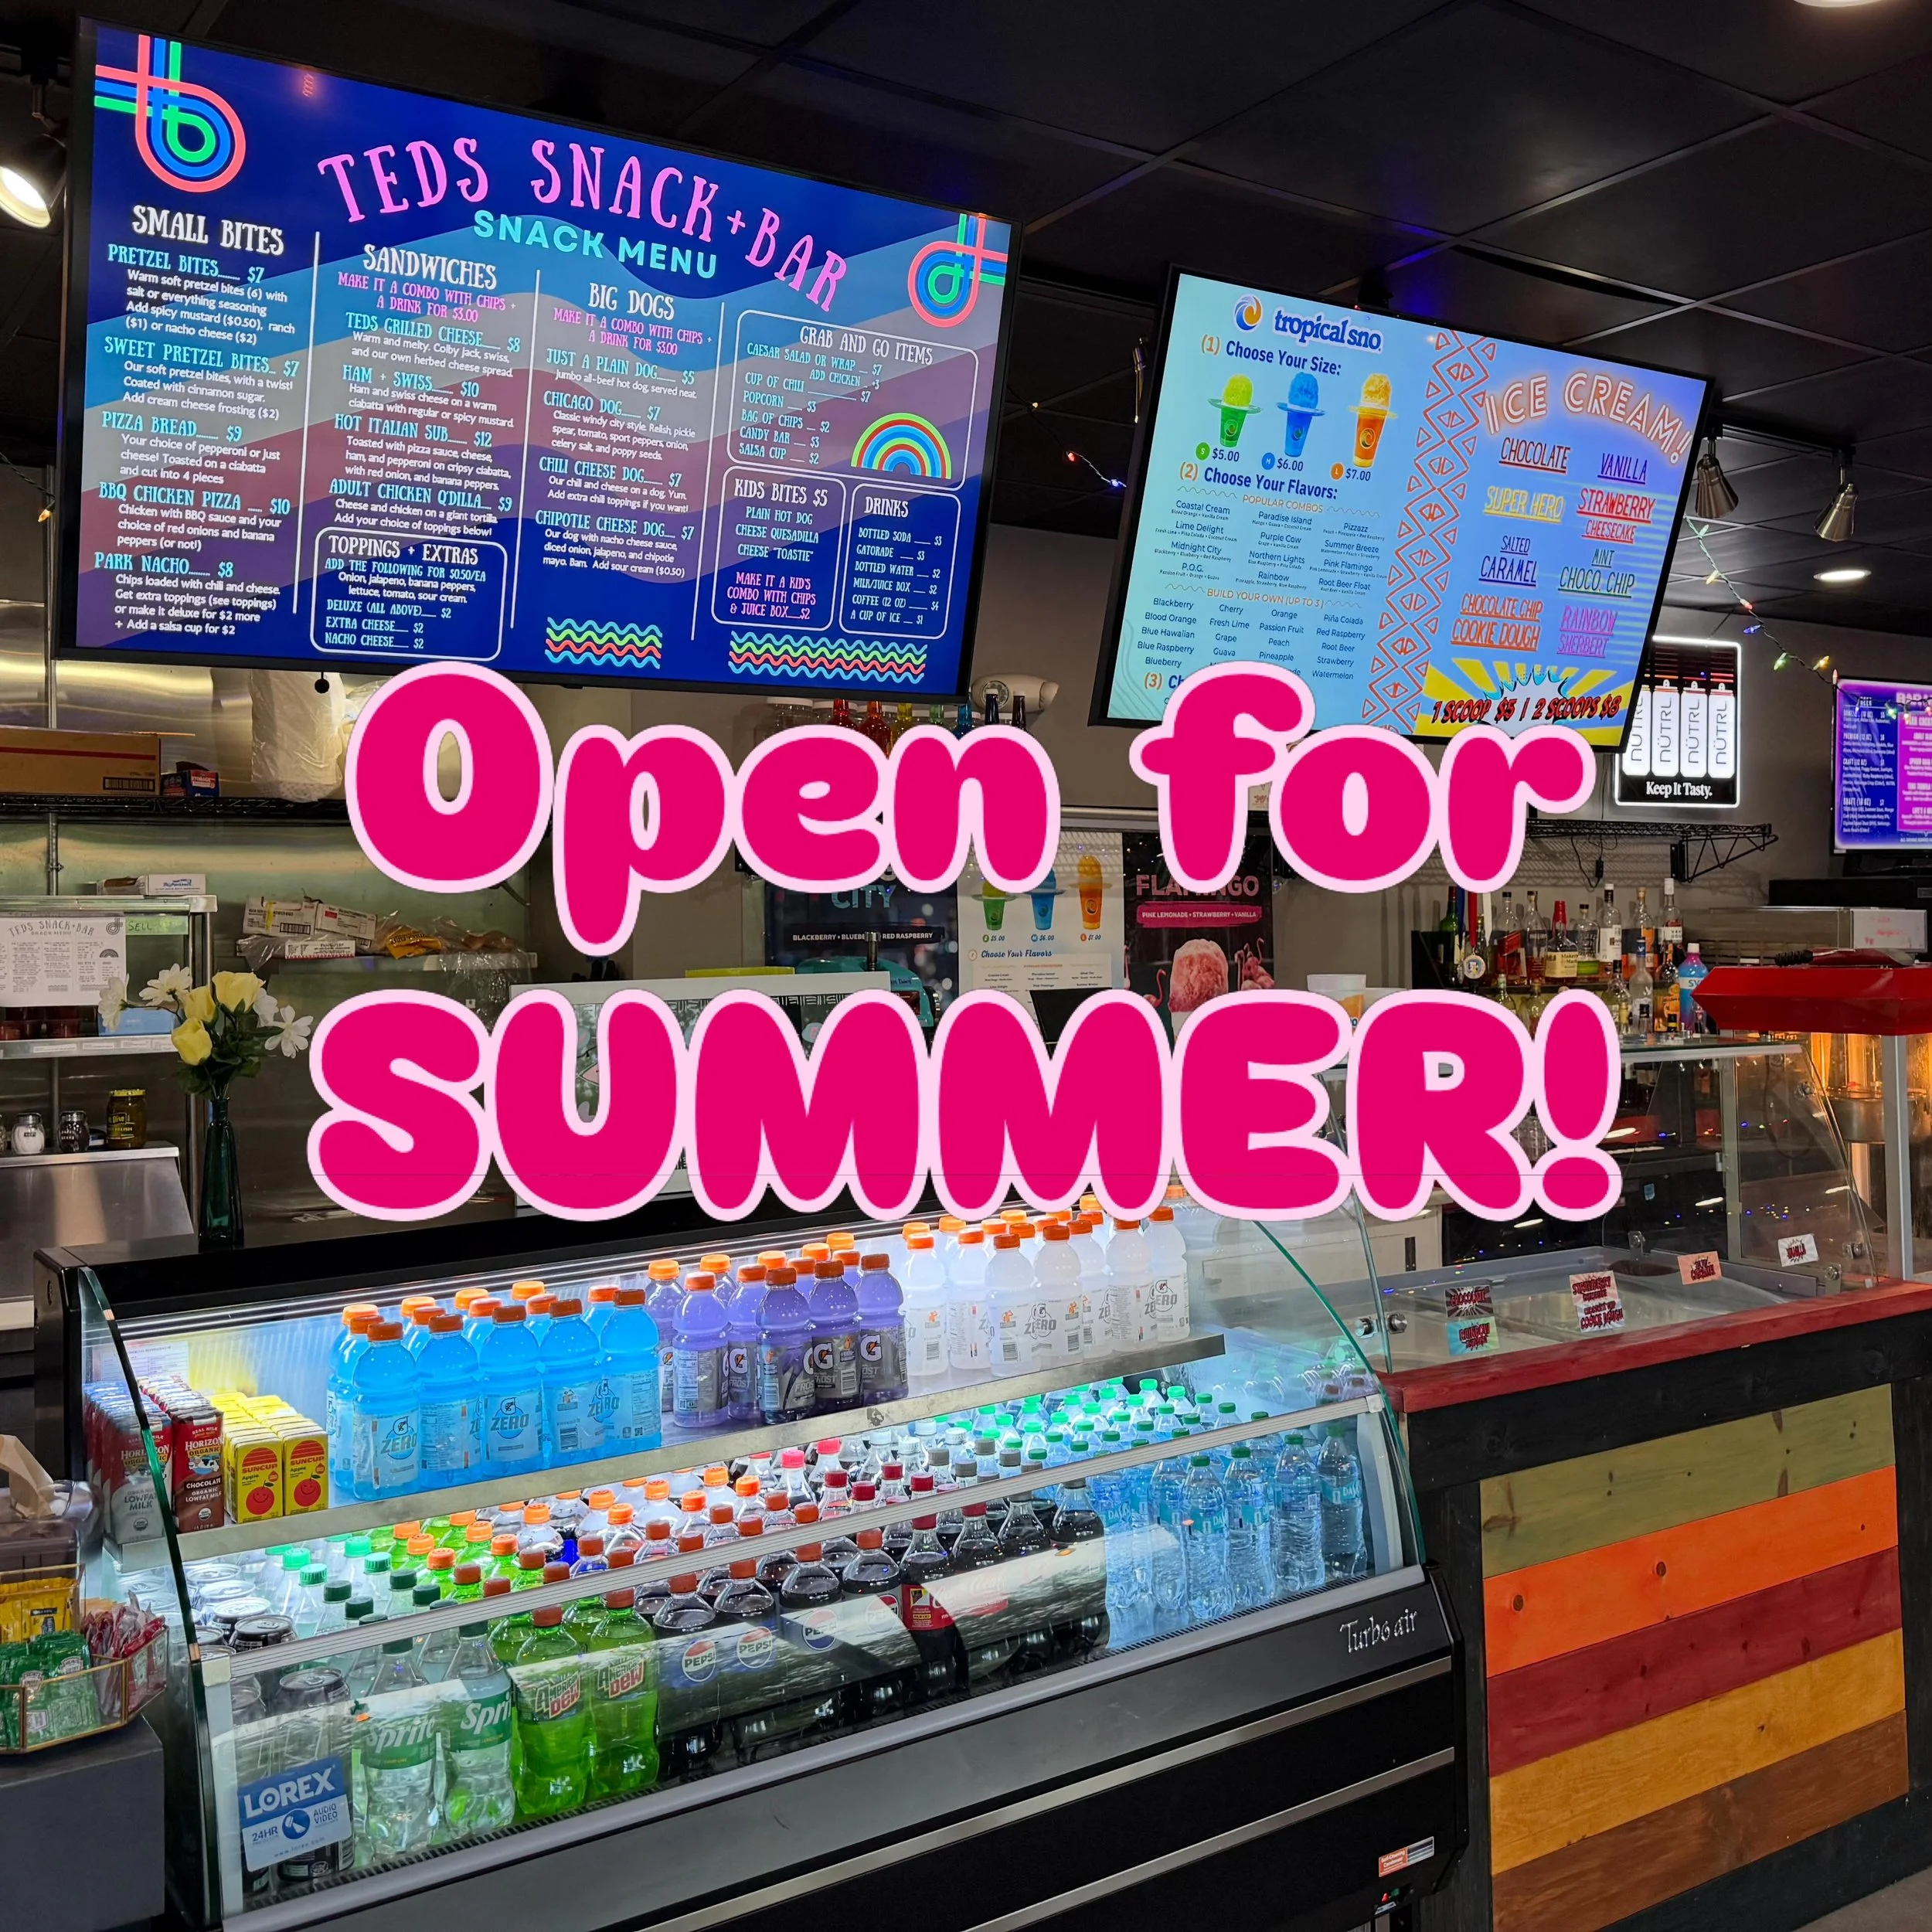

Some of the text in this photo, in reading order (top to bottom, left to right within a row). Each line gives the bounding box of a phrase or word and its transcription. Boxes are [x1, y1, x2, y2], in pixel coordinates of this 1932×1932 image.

[317, 138, 490, 223] TEDS
[132, 205, 284, 256] SMALL BITES
[473, 209, 716, 279] SNACK MENU
[363, 243, 496, 290] SANDWICHES
[128, 269, 287, 302] Warm soft pretzel bites (6) with
[588, 282, 675, 321] BIG DOGS
[800, 325, 934, 366] GRAB AND GO ITEMS
[1201, 334, 1342, 376] (1) Choose Your Size:
[1485, 372, 1693, 464] ICE CREAM!
[1212, 448, 1240, 462] $5.00
[1501, 437, 1570, 470] CHOCOLATE
[1277, 457, 1303, 471] $6.00
[1601, 453, 1648, 481] VANILLA
[1179, 462, 1338, 499] (2) Choose Your Flavors:
[1345, 470, 1371, 481] $7.00
[99, 481, 291, 515] BBQ CHICKEN PIZZA $10
[734, 479, 828, 507] KIDS BITES $5
[1486, 485, 1565, 518] SUPER HERO
[864, 496, 909, 518] DRINKS
[1243, 495, 1323, 513] POPULAR COMBOS
[1578, 488, 1655, 519] STRAWBERRY
[745, 505, 813, 525] PLAIN HOT DOG
[1258, 512, 1312, 526] Paradise Island
[736, 524, 819, 544] CHEESE QUESADILLA
[1343, 522, 1368, 533] Pizzazz
[1586, 519, 1637, 541] CHEESECAKE
[1260, 532, 1301, 544] Purple Cow
[1325, 539, 1379, 553] Summer Breeze
[1502, 536, 1530, 553] SALTED
[328, 535, 478, 565] TOPPINGS + EXTRAS
[855, 561, 940, 580] BOTTLED WATER $2
[1481, 556, 1537, 583] CARAMEL
[1318, 578, 1371, 590] Root Beer Float
[114, 605, 127, 614] or
[129, 605, 155, 616] make
[158, 606, 165, 615] it
[168, 607, 199, 618] deluxe
[202, 609, 216, 619] for
[219, 611, 233, 621] $2
[1452, 618, 1541, 648] COOKIE DOUGH
[1145, 657, 1182, 668] Blueberry
[1317, 656, 1354, 667] Strawberry
[1312, 670, 1354, 680] Watermelon
[1442, 699, 1492, 723] SCOOP
[1495, 697, 1517, 723] $5
[1532, 699, 1547, 719] 2
[1546, 696, 1597, 722] SCOOPS
[1599, 694, 1622, 720] $8
[1646, 781, 1713, 800] Keep It Tasty.
[9, 922, 33, 937] TEDS
[490, 1413, 530, 1431] ZERO
[185, 1436, 223, 1451] HORIZON
[189, 1447, 220, 1456] ORGANIC
[242, 1464, 278, 1474] SUNCUP
[291, 1456, 325, 1466] SUNCUP
[242, 1473, 259, 1481] Apple
[192, 1487, 218, 1496] ORGANIC
[130, 1501, 153, 1511] MILK
[1340, 1609, 1417, 1653] Turbo air
[739, 1641, 772, 1654] PEPSI
[684, 1653, 716, 1668] PEPSI
[369, 1713, 436, 1753] Sprite
[243, 1767, 335, 1818] LOREX
[313, 1803, 337, 1817] AUDIO
[315, 1811, 338, 1824] VIDEO
[252, 1826, 278, 1842] 24HR
